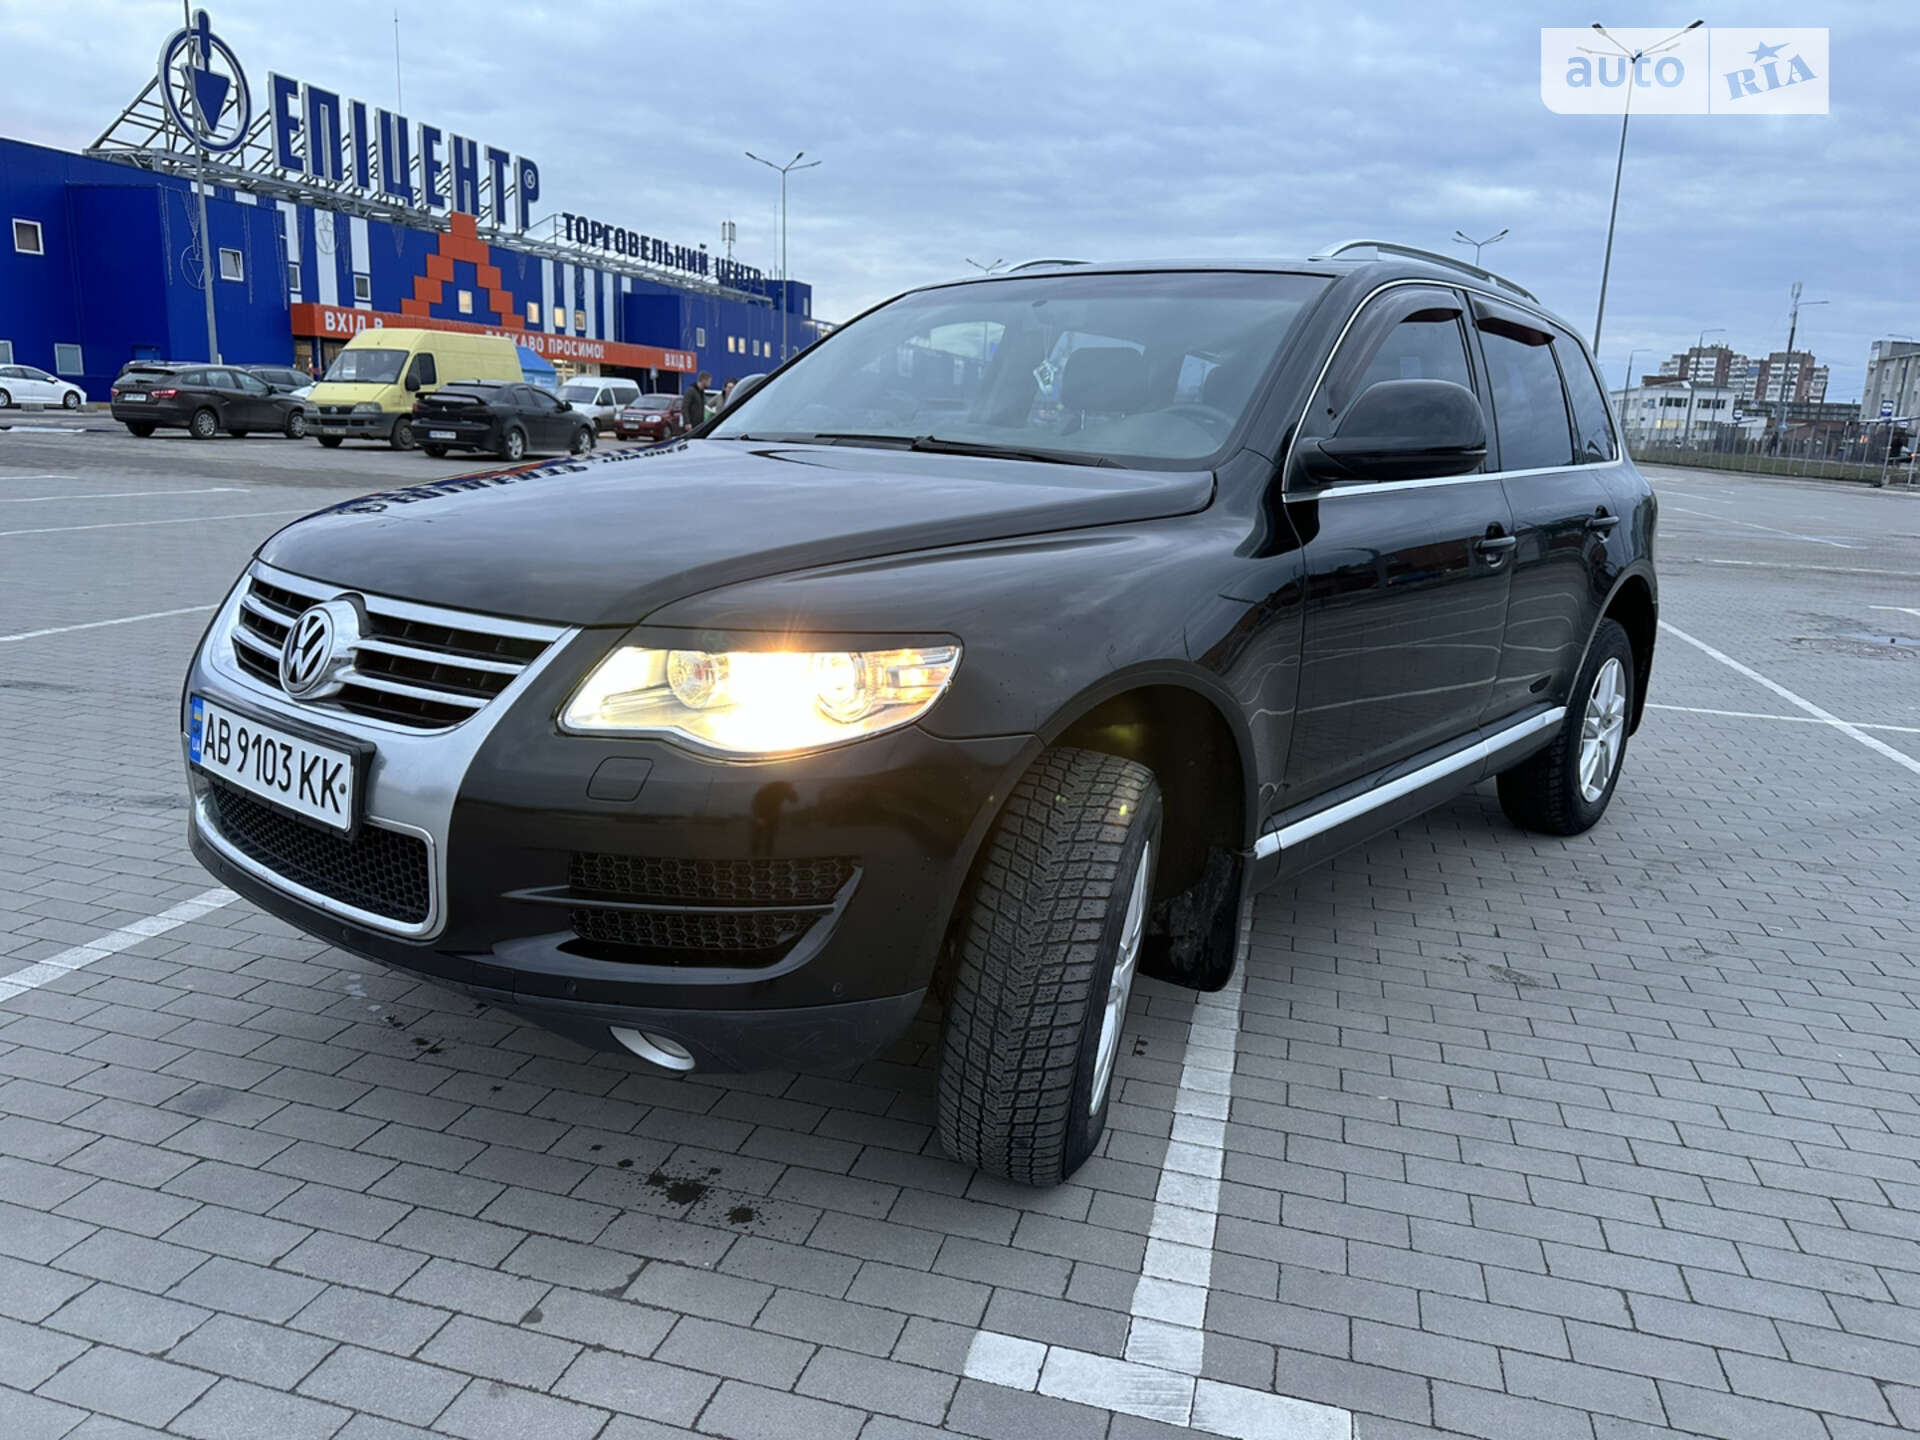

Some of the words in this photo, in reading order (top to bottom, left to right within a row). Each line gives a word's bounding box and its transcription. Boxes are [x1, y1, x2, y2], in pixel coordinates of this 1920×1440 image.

[269, 72, 540, 230] ЕПІЦЕНТР
[562, 212, 709, 276] ТОРГОВЕЛЬНИЙ
[715, 256, 762, 291] ЦЕНТР
[485, 330, 545, 352] КАВО
[548, 337, 605, 360] ПРОСИМО!
[203, 712, 232, 766] AB
[236, 726, 293, 793] 9103
[298, 750, 344, 814] KK
